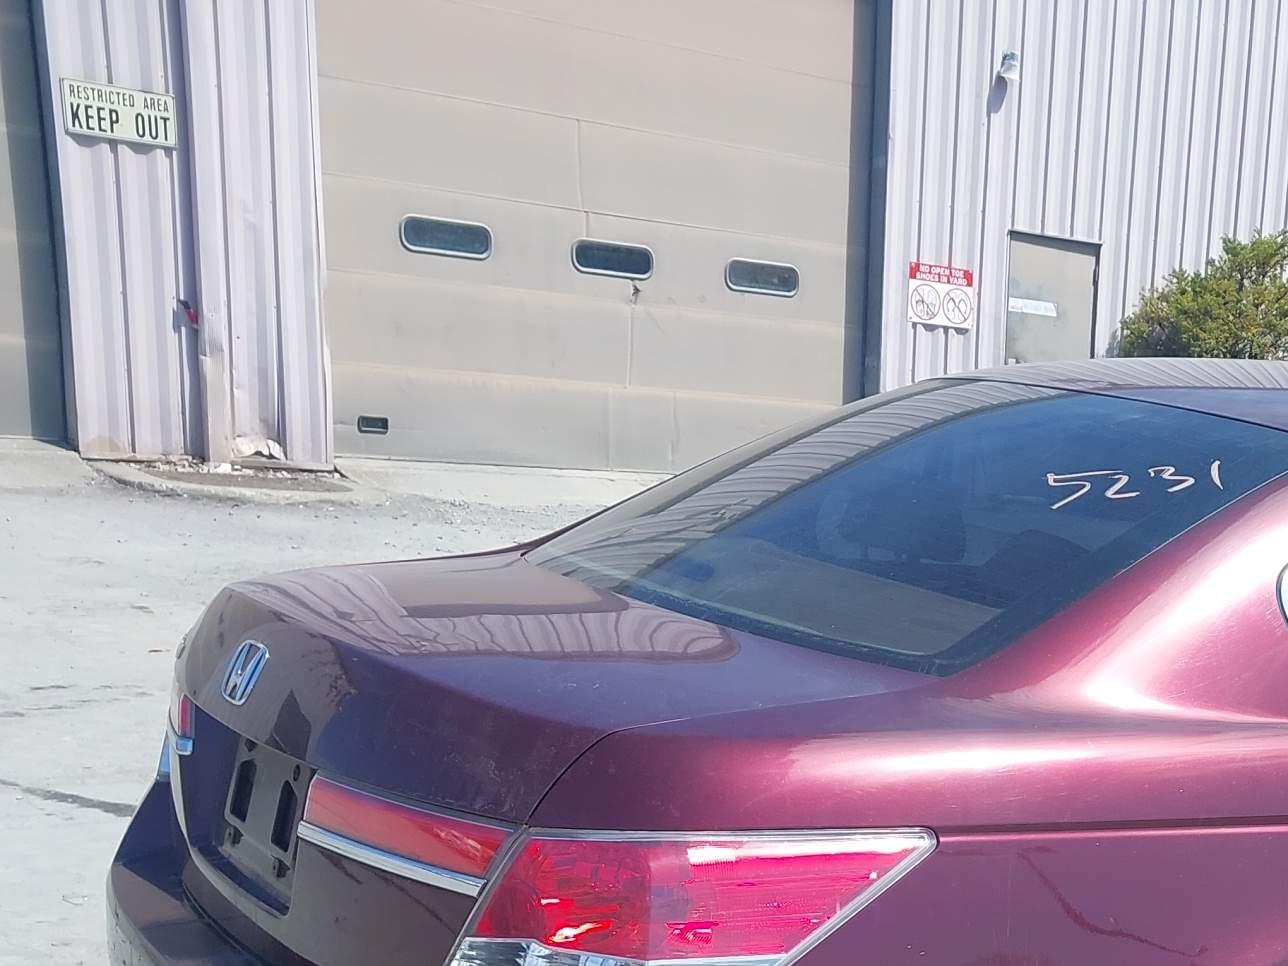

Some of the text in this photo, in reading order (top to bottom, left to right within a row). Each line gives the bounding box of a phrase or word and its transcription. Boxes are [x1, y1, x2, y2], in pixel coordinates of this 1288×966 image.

[69, 83, 170, 113] RESTRICTED AREA
[70, 102, 170, 142] KEEP OUT
[915, 271, 968, 286] SHOES IN YARD
[919, 264, 965, 278] NO OPEN TOE
[1046, 461, 1224, 510] 5231
